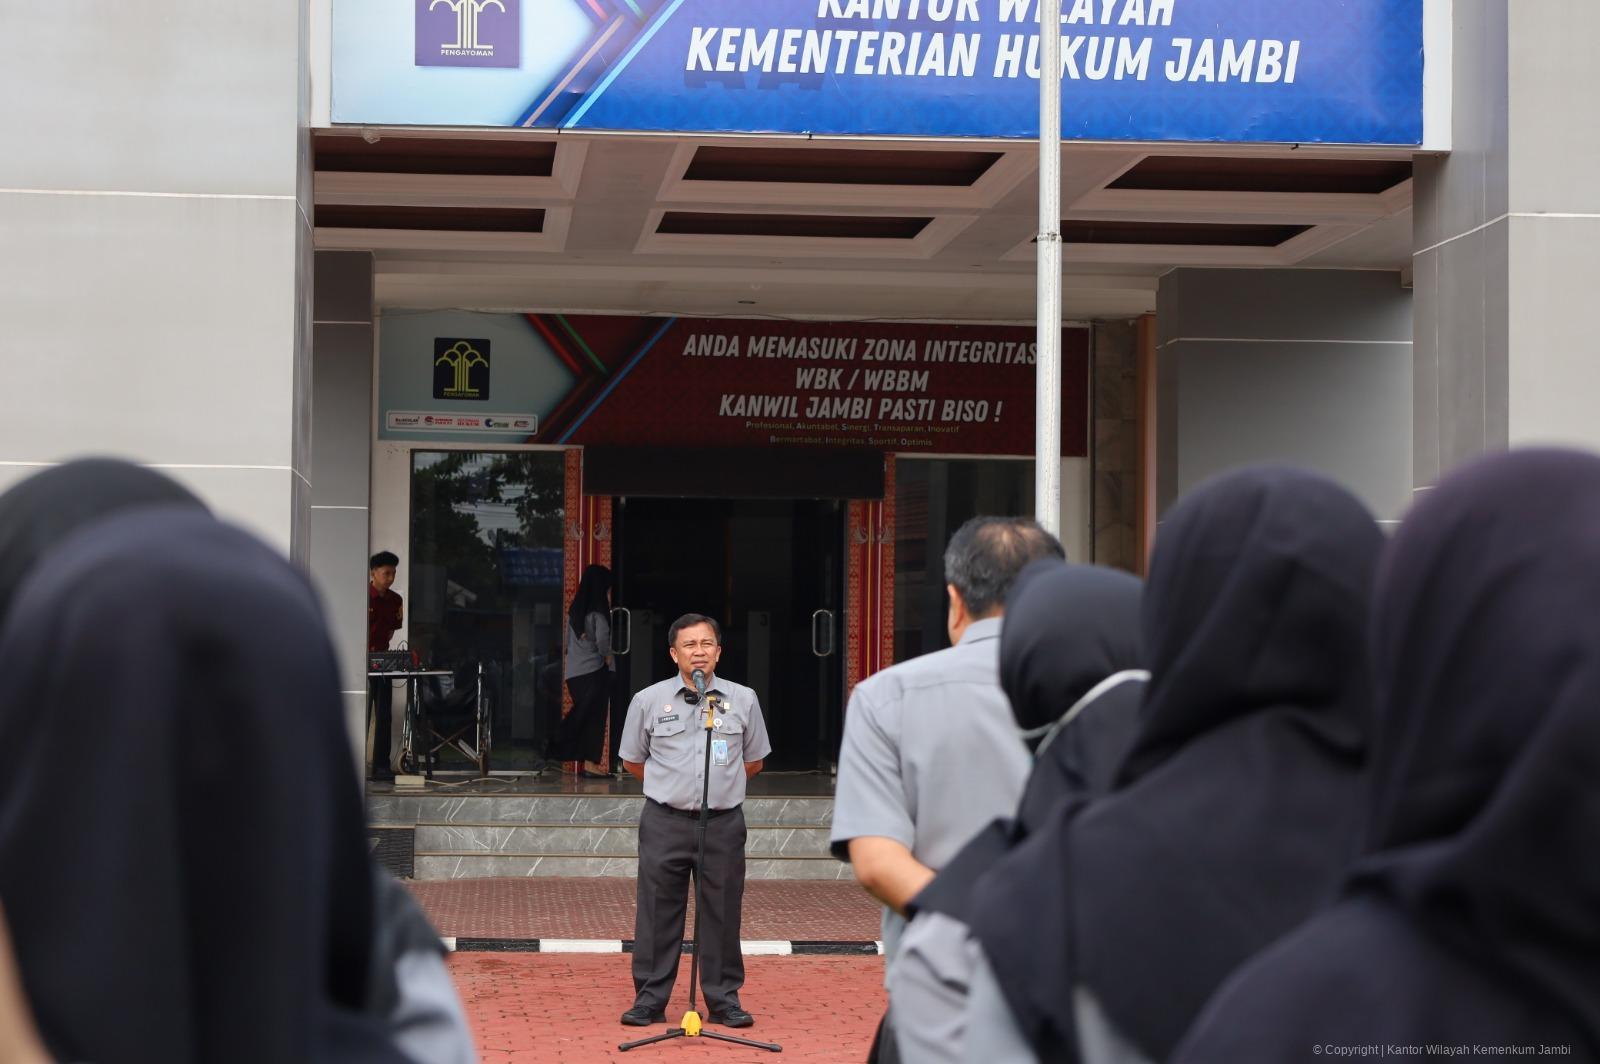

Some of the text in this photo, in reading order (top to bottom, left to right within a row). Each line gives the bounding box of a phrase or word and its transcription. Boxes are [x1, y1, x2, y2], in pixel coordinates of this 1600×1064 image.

[685, 27, 981, 77] KEMENTERIAN
[1165, 38, 1300, 84] JAMBI
[682, 334, 1037, 364] ANDA MEMASUKI ZONA INTEGRITAS
[795, 367, 843, 390] WBK
[864, 369, 930, 392] WBBM
[719, 394, 799, 417] KANWIL
[805, 396, 873, 419] JAMBI
[878, 398, 936, 421] PASTI
[940, 399, 989, 422] BISO
[901, 437, 933, 447] Optimis
[928, 425, 960, 433] Inovatif
